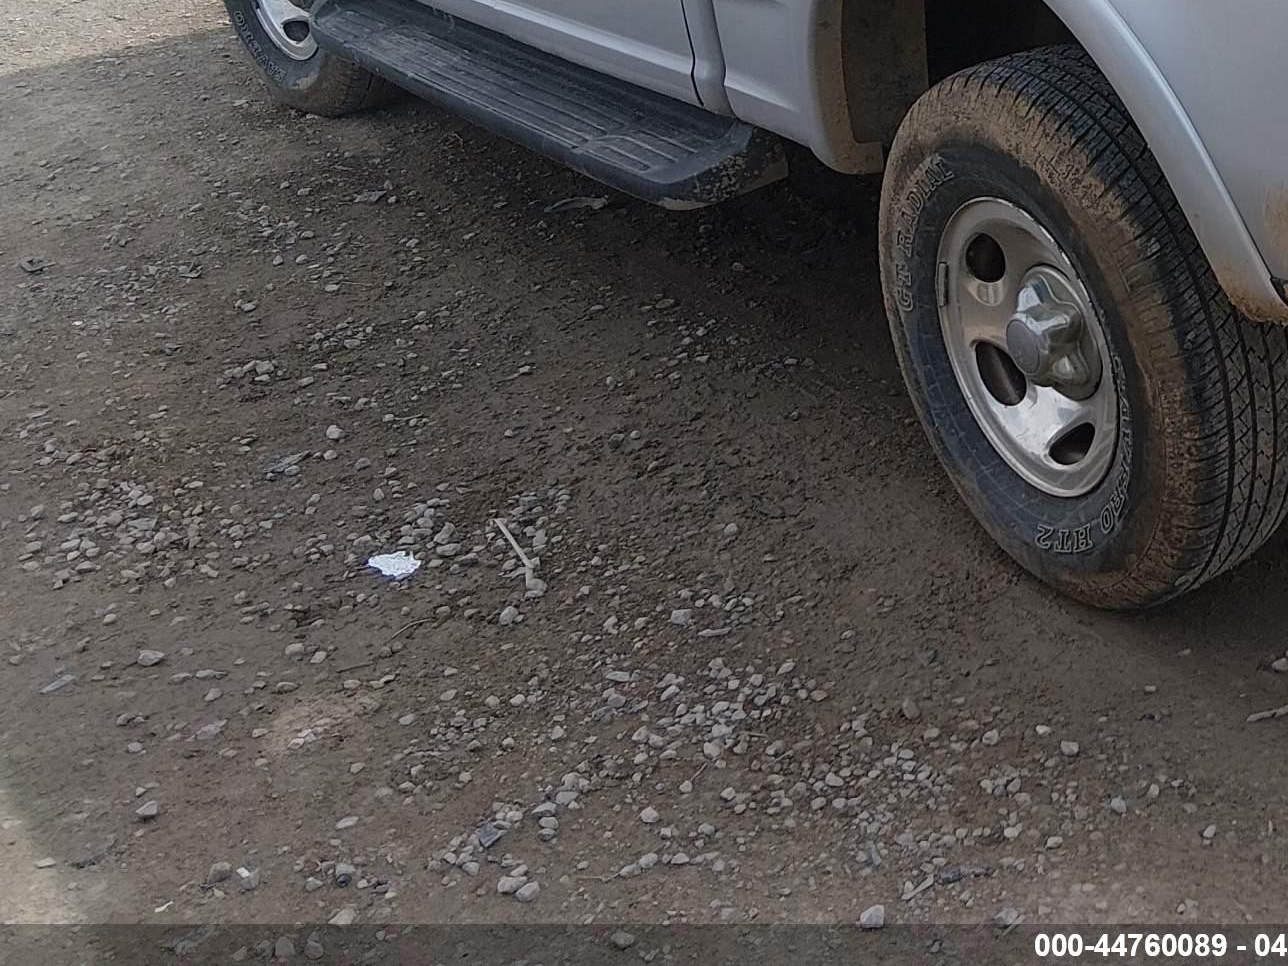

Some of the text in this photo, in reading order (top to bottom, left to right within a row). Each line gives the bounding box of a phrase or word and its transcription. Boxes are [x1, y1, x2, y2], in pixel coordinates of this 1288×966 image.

[893, 152, 956, 313] GT RADIAL
[1034, 522, 1093, 553] HT2
